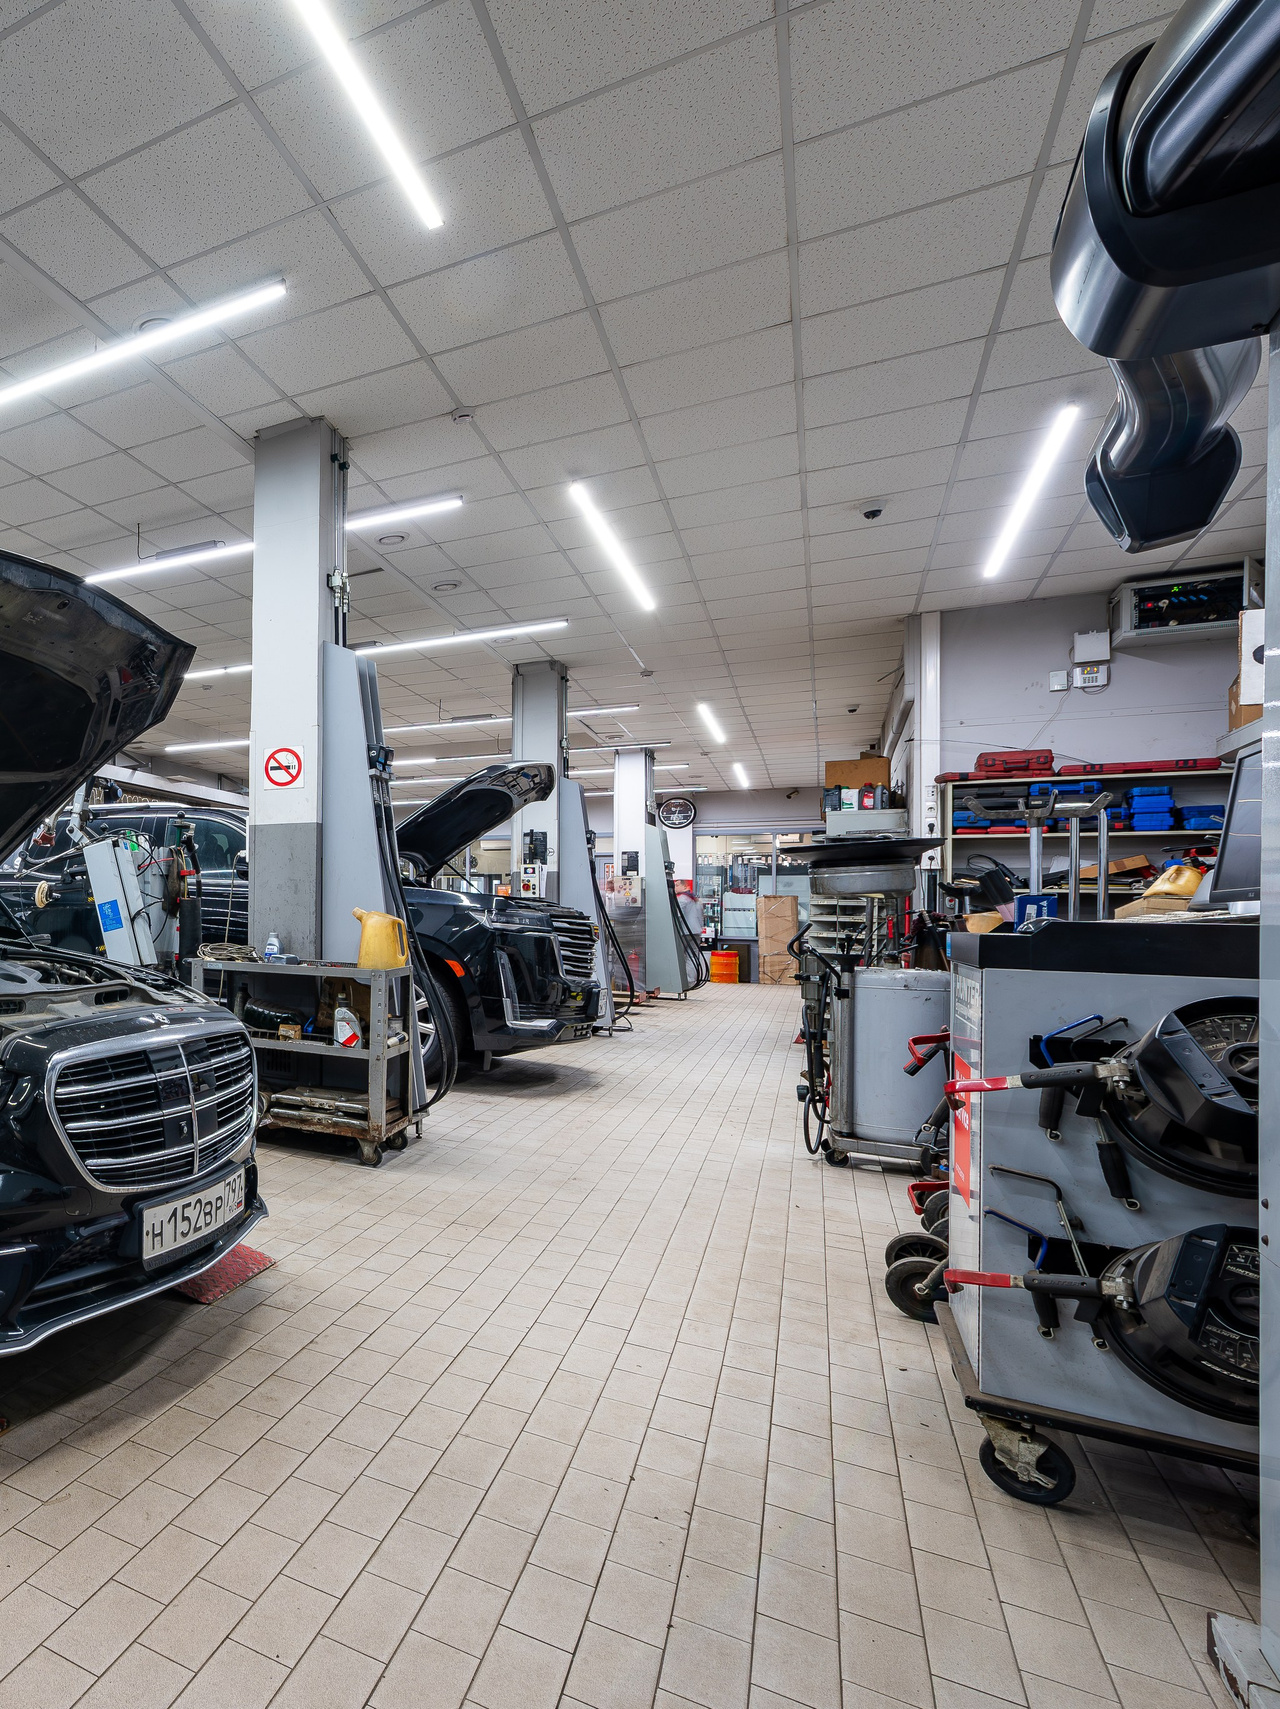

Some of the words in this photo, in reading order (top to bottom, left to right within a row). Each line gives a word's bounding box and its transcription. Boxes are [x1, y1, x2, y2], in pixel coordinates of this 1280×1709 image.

[956, 974, 980, 1008] HUNTER
[226, 1173, 243, 1207] 797
[1226, 1265, 1260, 1280] HUNTER
